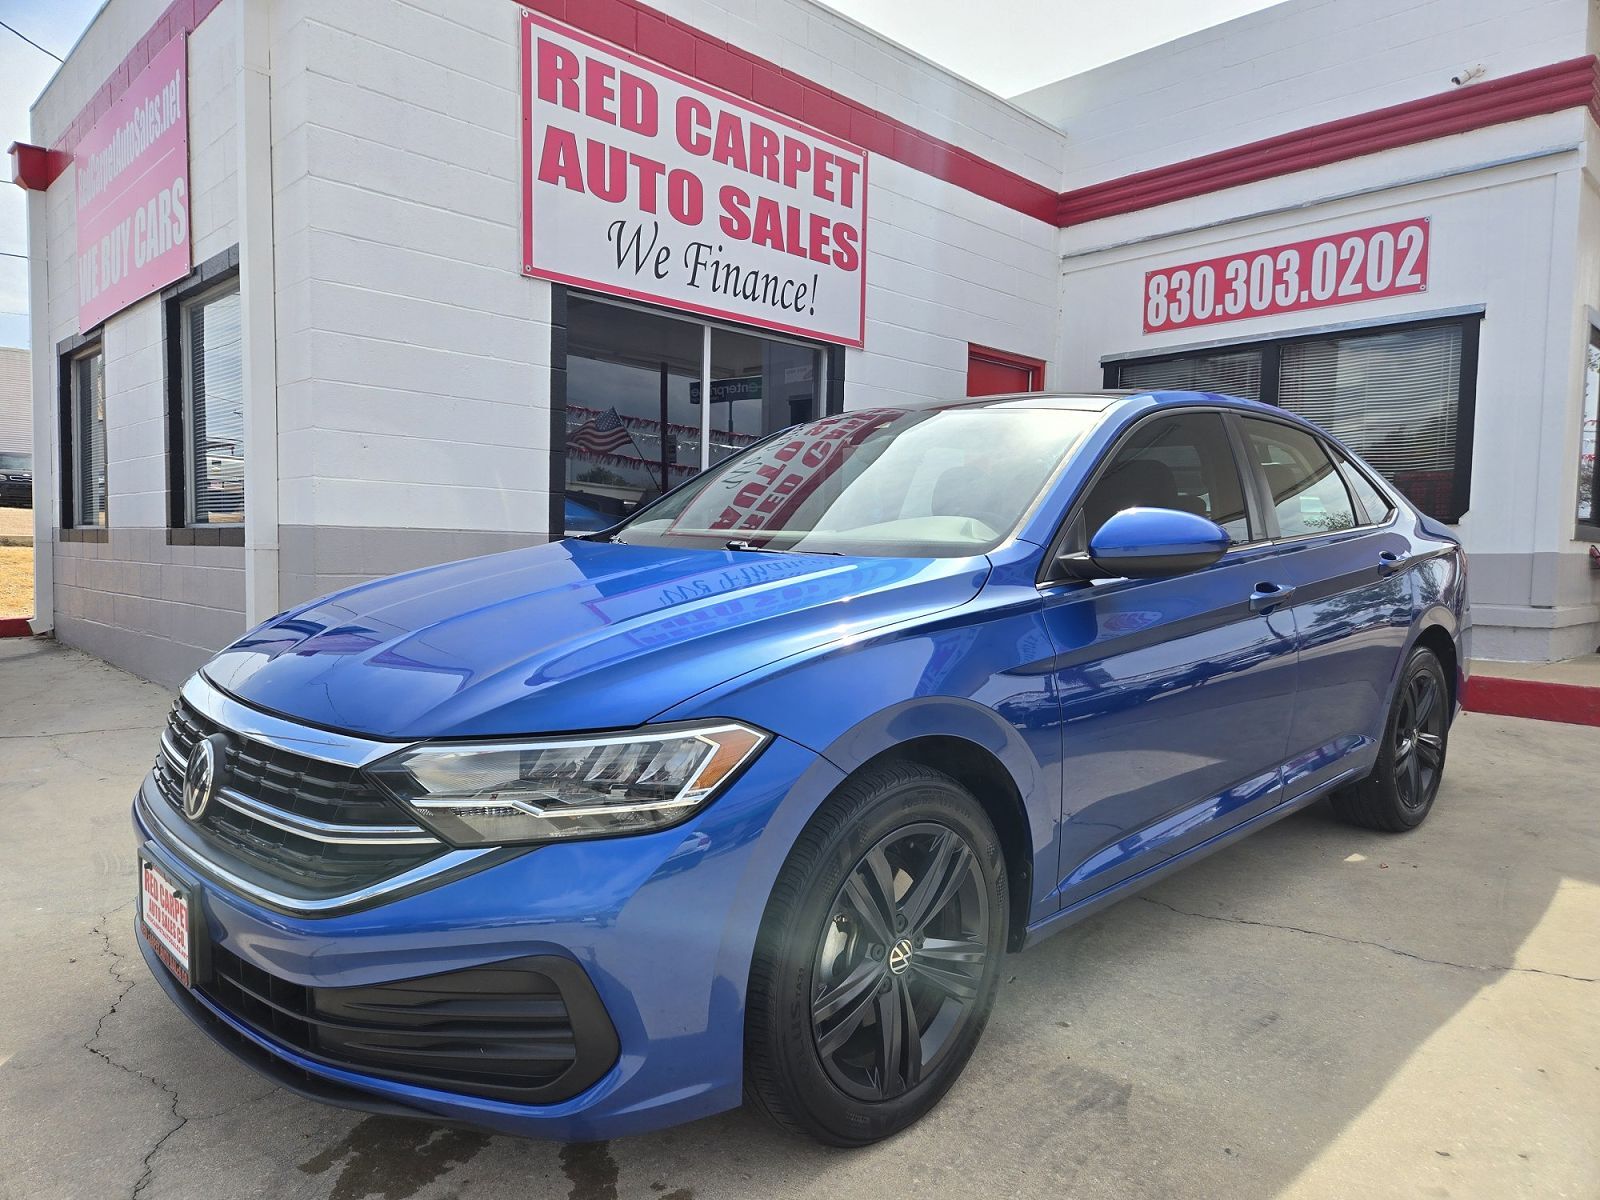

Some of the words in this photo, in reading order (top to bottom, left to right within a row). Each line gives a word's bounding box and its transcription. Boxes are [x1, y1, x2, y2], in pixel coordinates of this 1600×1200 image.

[537, 36, 659, 138] RED
[675, 95, 860, 209] CARPET
[79, 243, 98, 306] WE
[101, 215, 131, 292] BUY
[134, 177, 186, 269] CARS
[537, 124, 704, 226] AUTO
[718, 184, 859, 272] SALES
[607, 220, 671, 279] We
[683, 241, 818, 316] Finance!
[1147, 225, 1425, 327] 830.303.0202
[144, 868, 159, 902] RED
